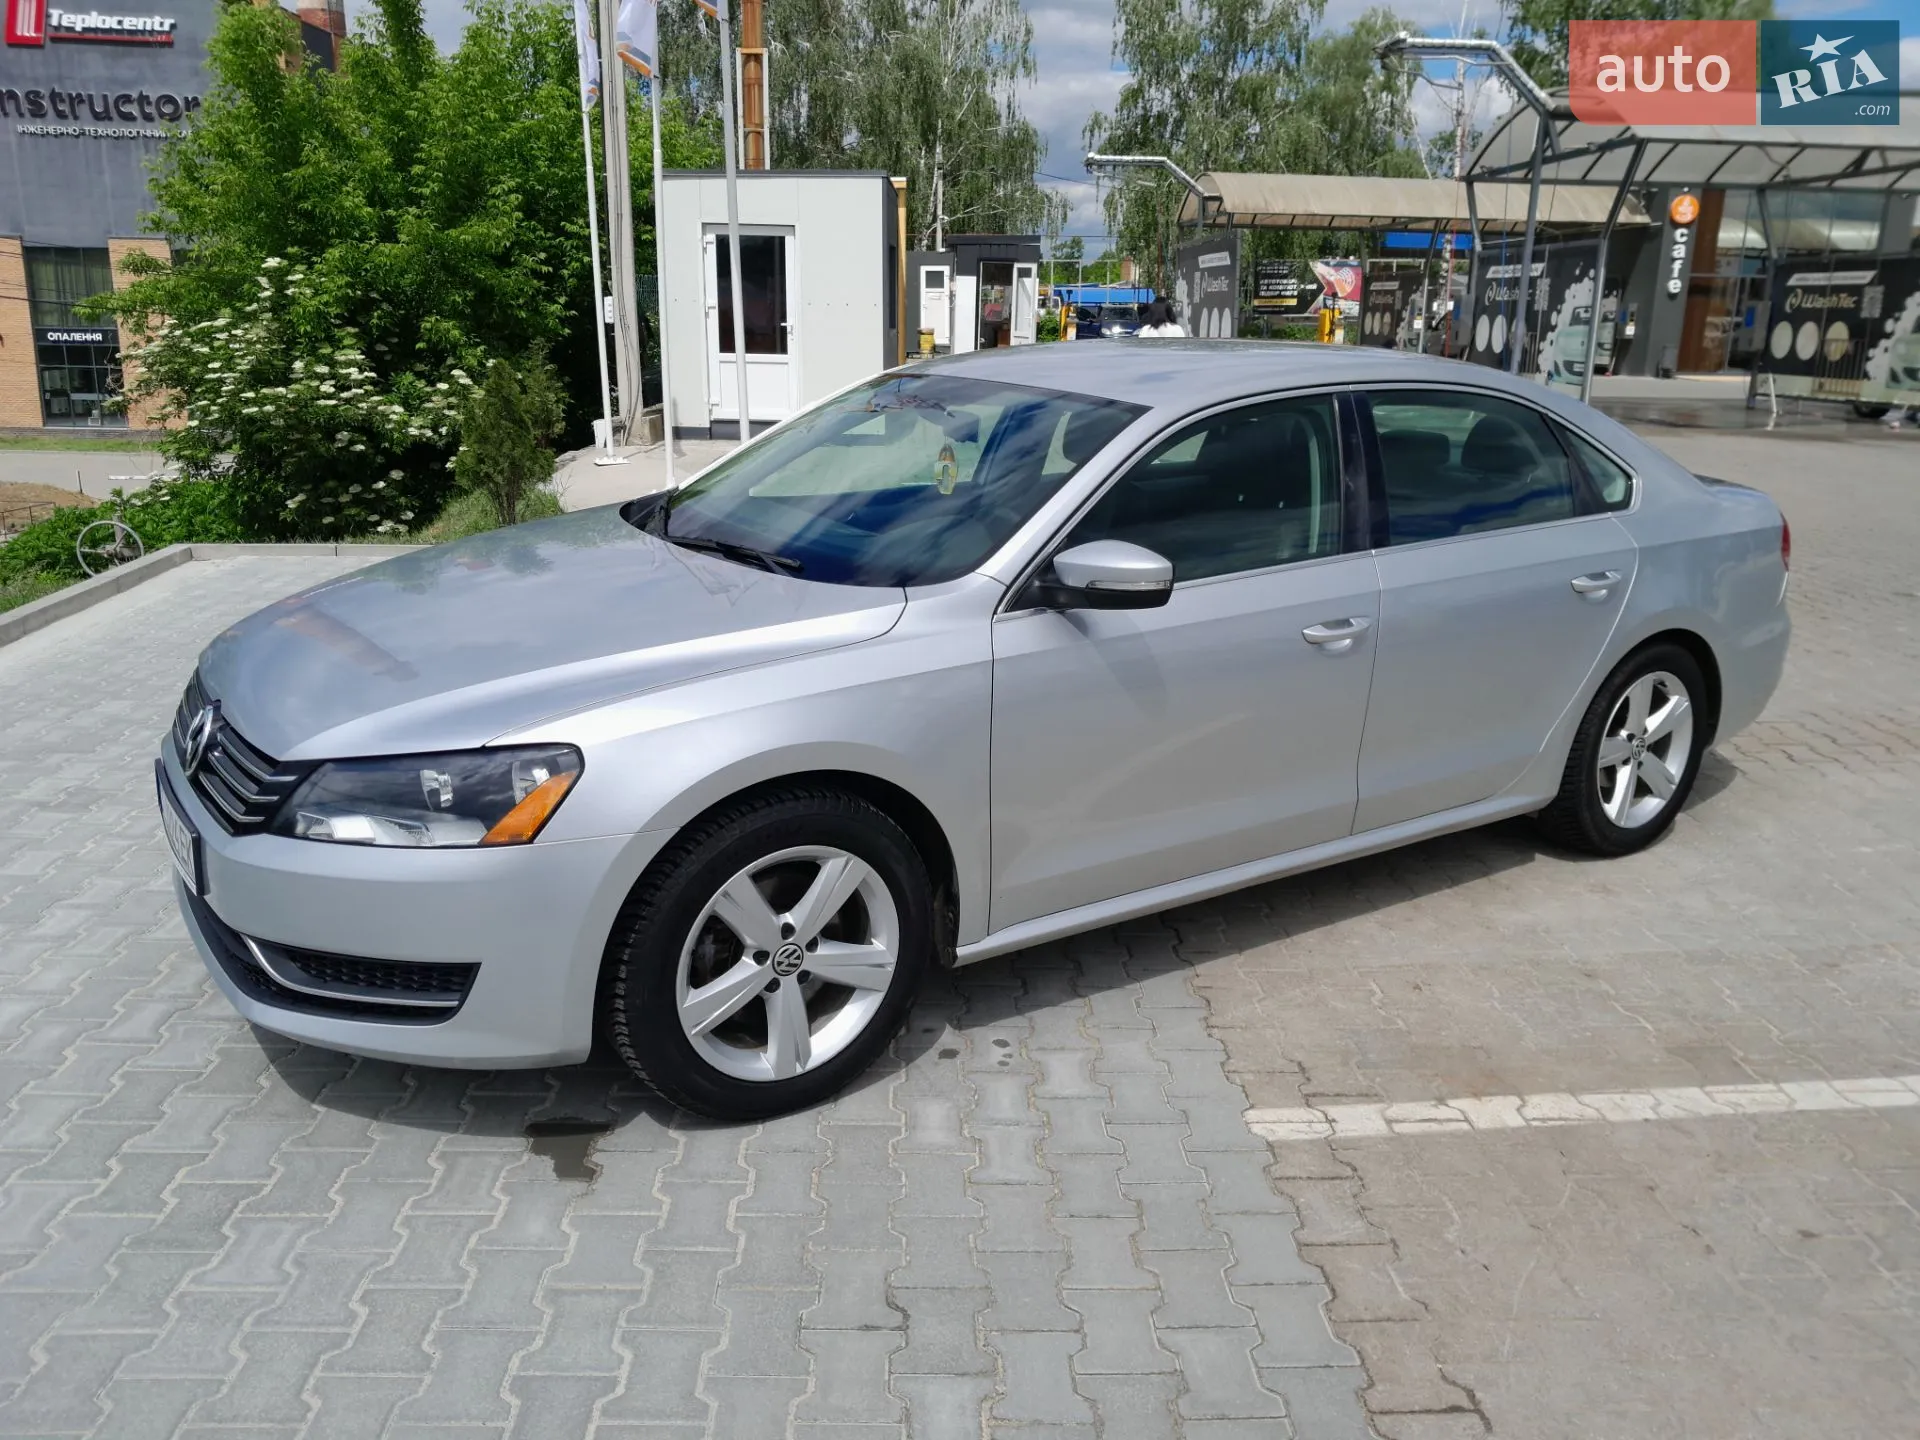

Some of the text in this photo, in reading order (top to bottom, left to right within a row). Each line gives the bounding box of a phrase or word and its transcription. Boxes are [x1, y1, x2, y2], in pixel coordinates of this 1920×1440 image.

[48, 8, 176, 32] Teplocentr
[1667, 228, 1689, 293] cafe
[1801, 292, 1858, 308] WashTec
[47, 332, 103, 341] ОПАЛЕННЯ
